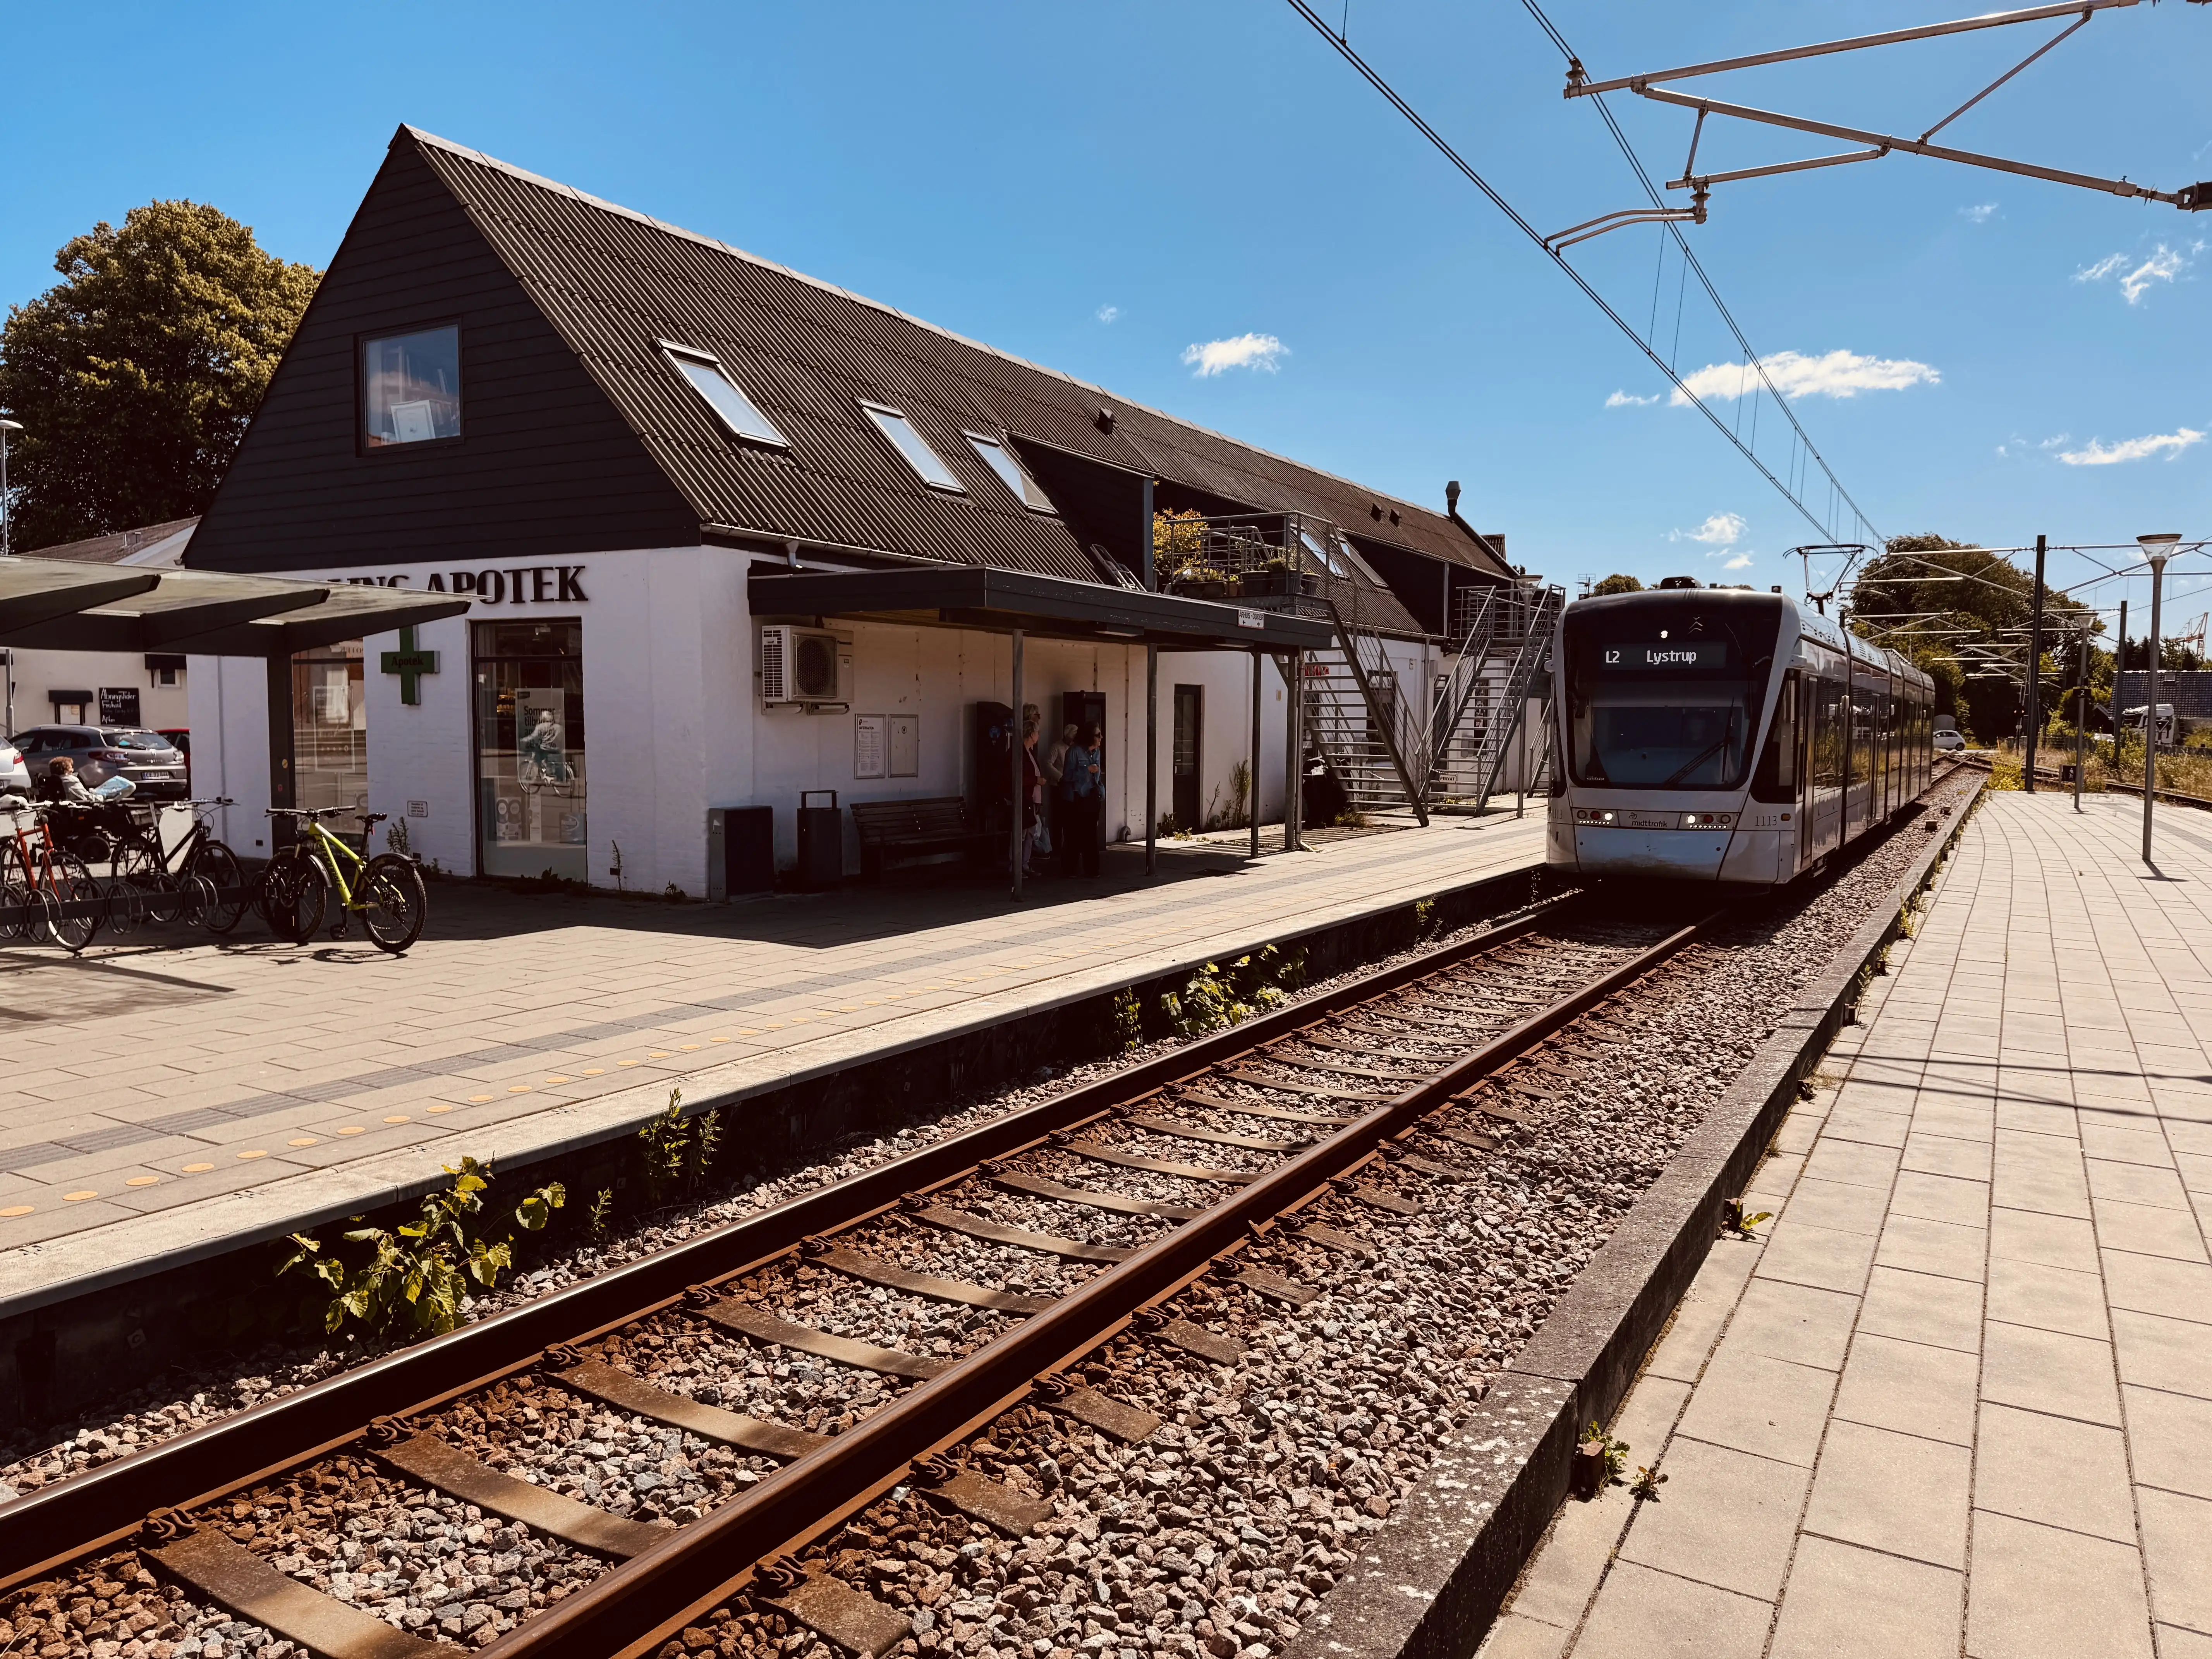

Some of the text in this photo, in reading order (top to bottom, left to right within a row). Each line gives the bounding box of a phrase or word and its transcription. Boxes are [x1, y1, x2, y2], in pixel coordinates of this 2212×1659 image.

[427, 565, 589, 604] APOTEK
[392, 655, 424, 668] Apotek
[1606, 650, 1697, 665] L2 Lystrup
[1755, 816, 1777, 826] 1113
